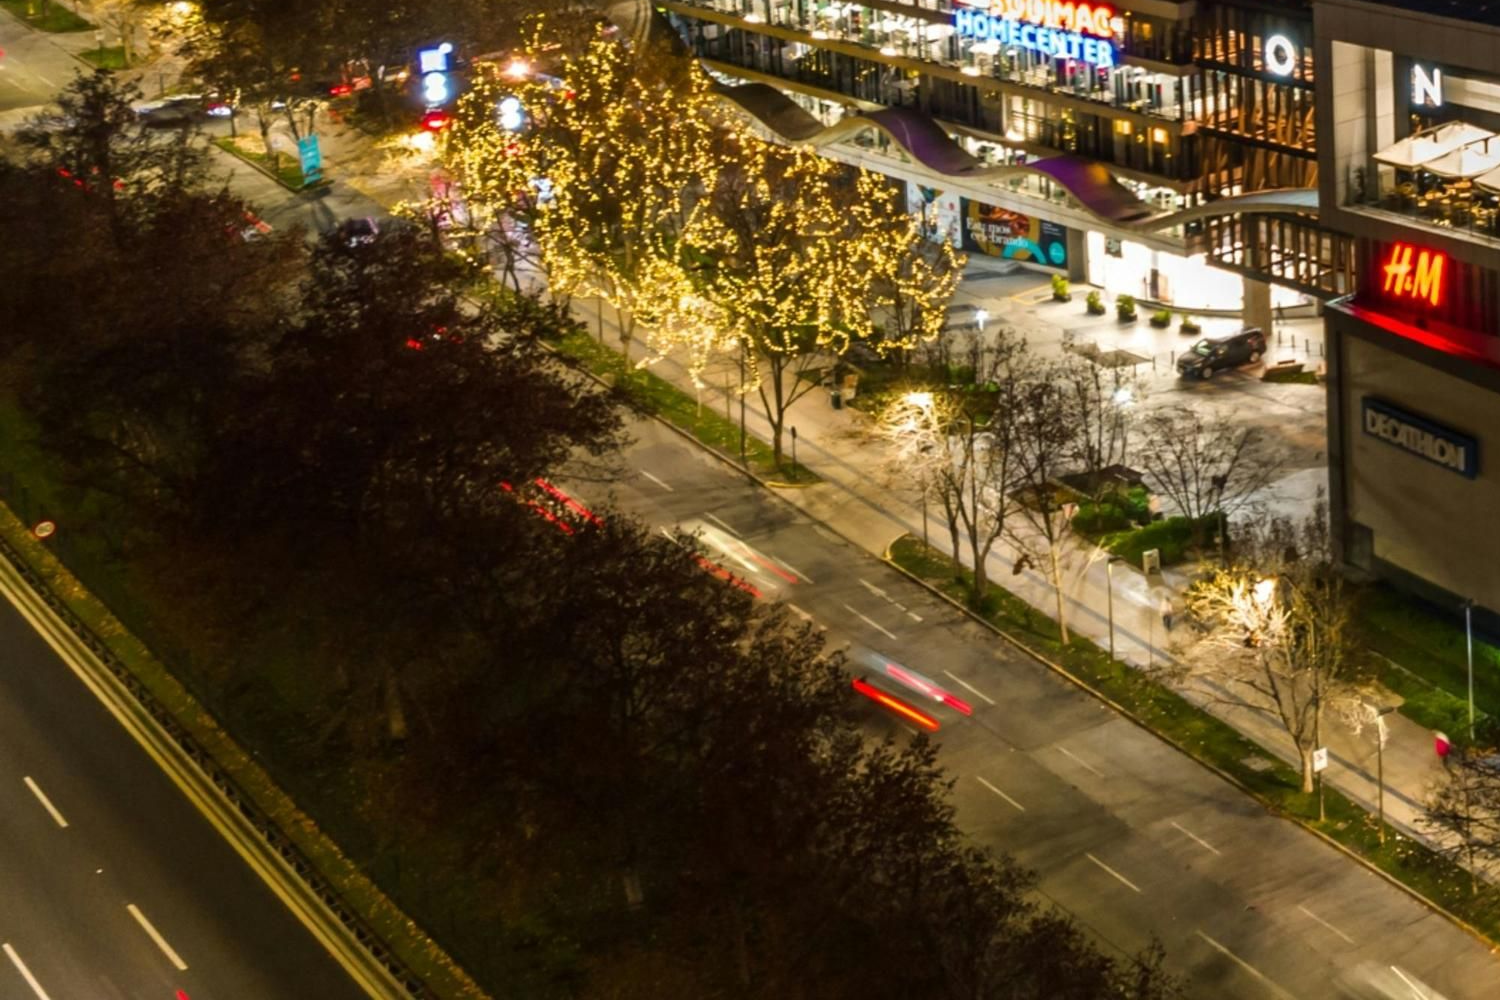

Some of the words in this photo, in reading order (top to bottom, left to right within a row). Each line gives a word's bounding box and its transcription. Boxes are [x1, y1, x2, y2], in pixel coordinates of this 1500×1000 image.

[955, 9, 1114, 67] HOMECENTER
[1413, 63, 1442, 107] N
[1384, 244, 1443, 306] H&M
[1365, 408, 1466, 472] DECATHLON
